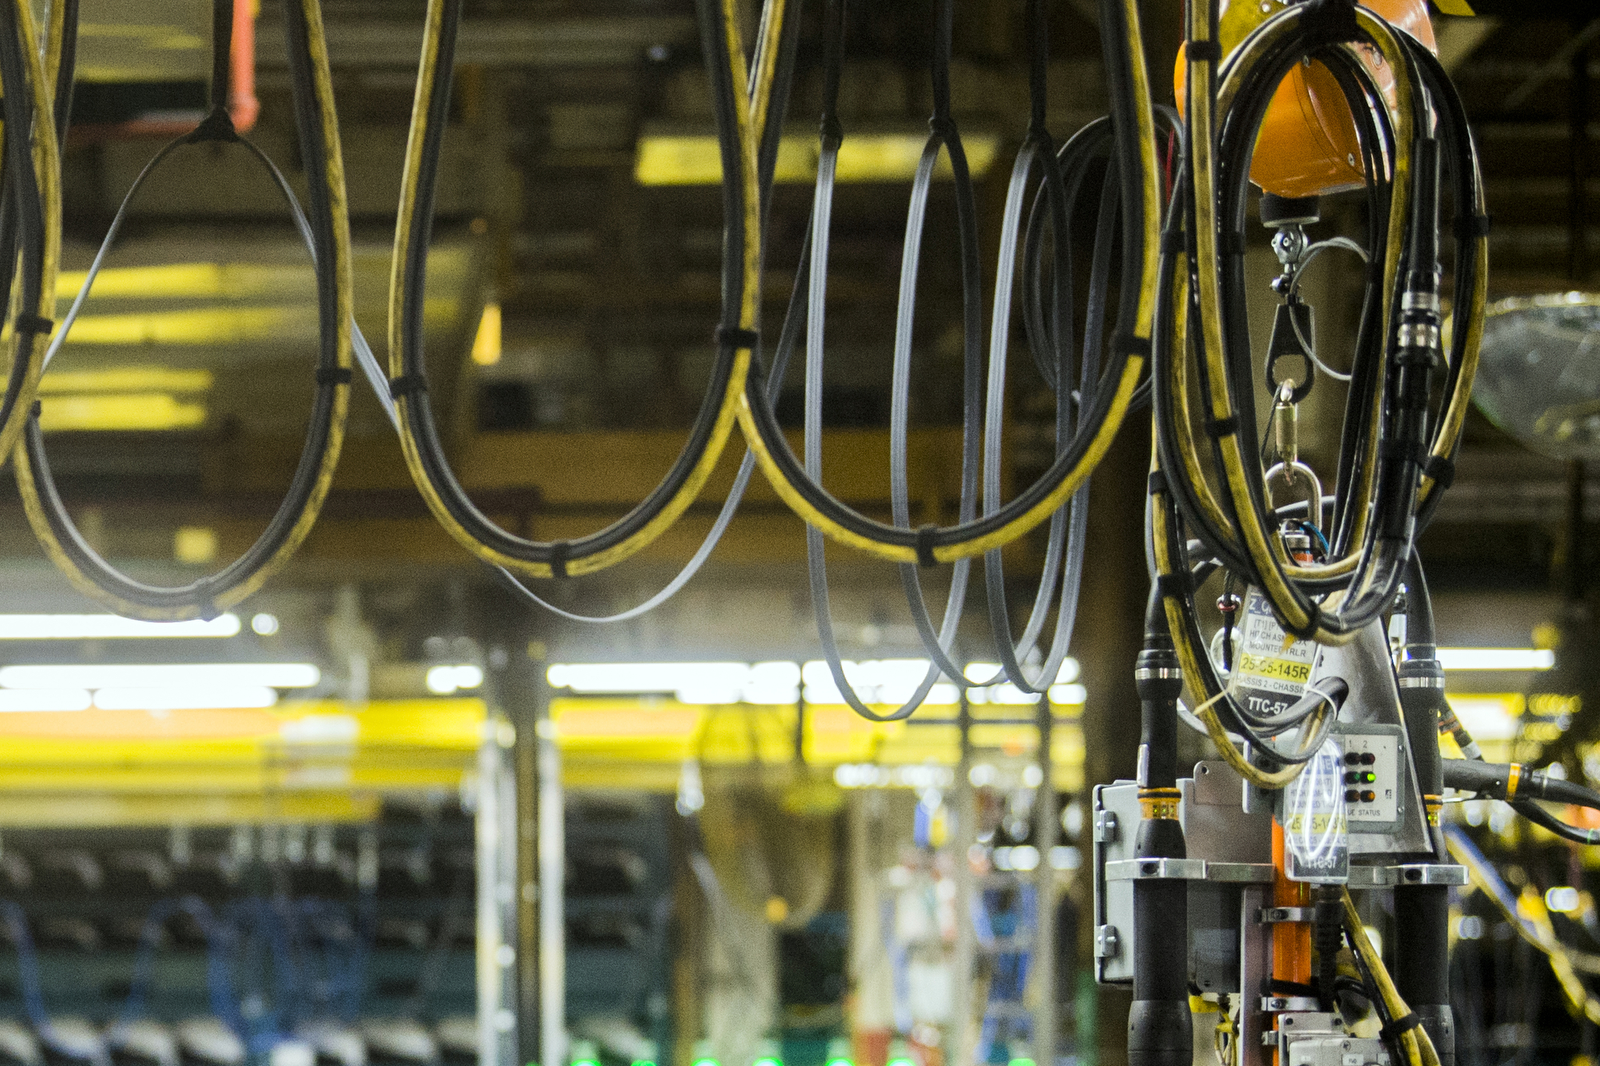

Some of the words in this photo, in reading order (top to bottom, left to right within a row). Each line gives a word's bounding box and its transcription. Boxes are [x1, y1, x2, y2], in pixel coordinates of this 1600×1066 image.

[1248, 696, 1288, 715] TTC-57
[1348, 739, 1352, 748] 1
[1362, 740, 1368, 749] 2
[1358, 808, 1381, 817] STATUS
